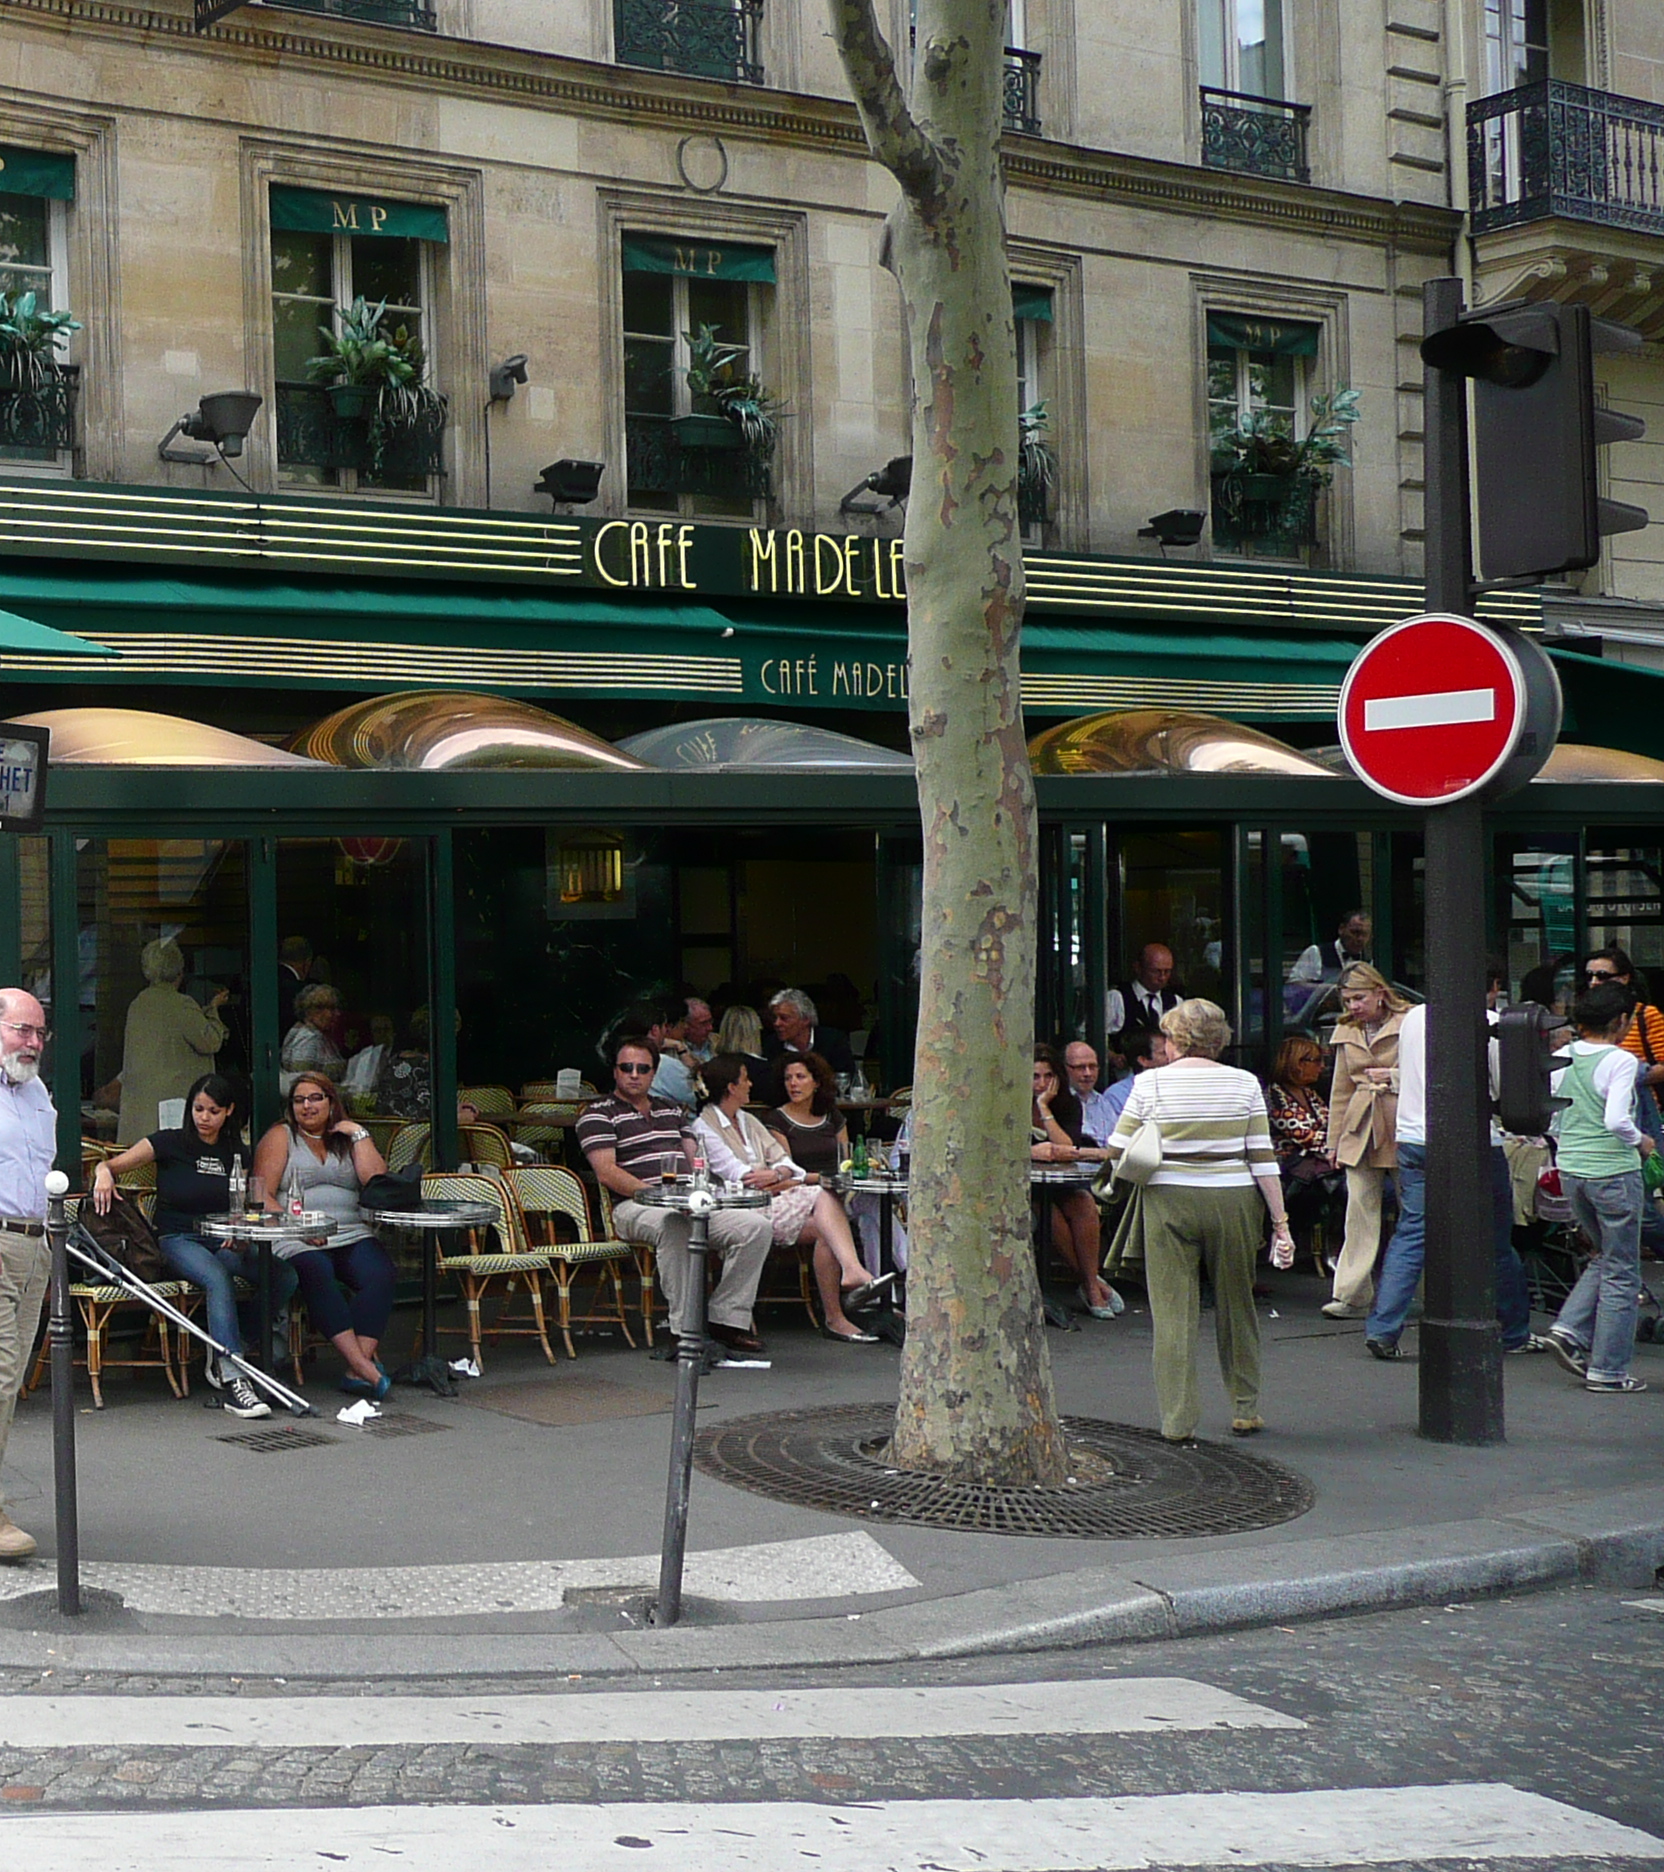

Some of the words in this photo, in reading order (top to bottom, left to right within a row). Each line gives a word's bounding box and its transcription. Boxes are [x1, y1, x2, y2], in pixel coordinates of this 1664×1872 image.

[594, 521, 697, 588] CAFE
[749, 527, 907, 599] MADELE
[760, 653, 818, 695] CAFÉ
[832, 661, 909, 699] MADEL
[4, 794, 10, 812] 1
